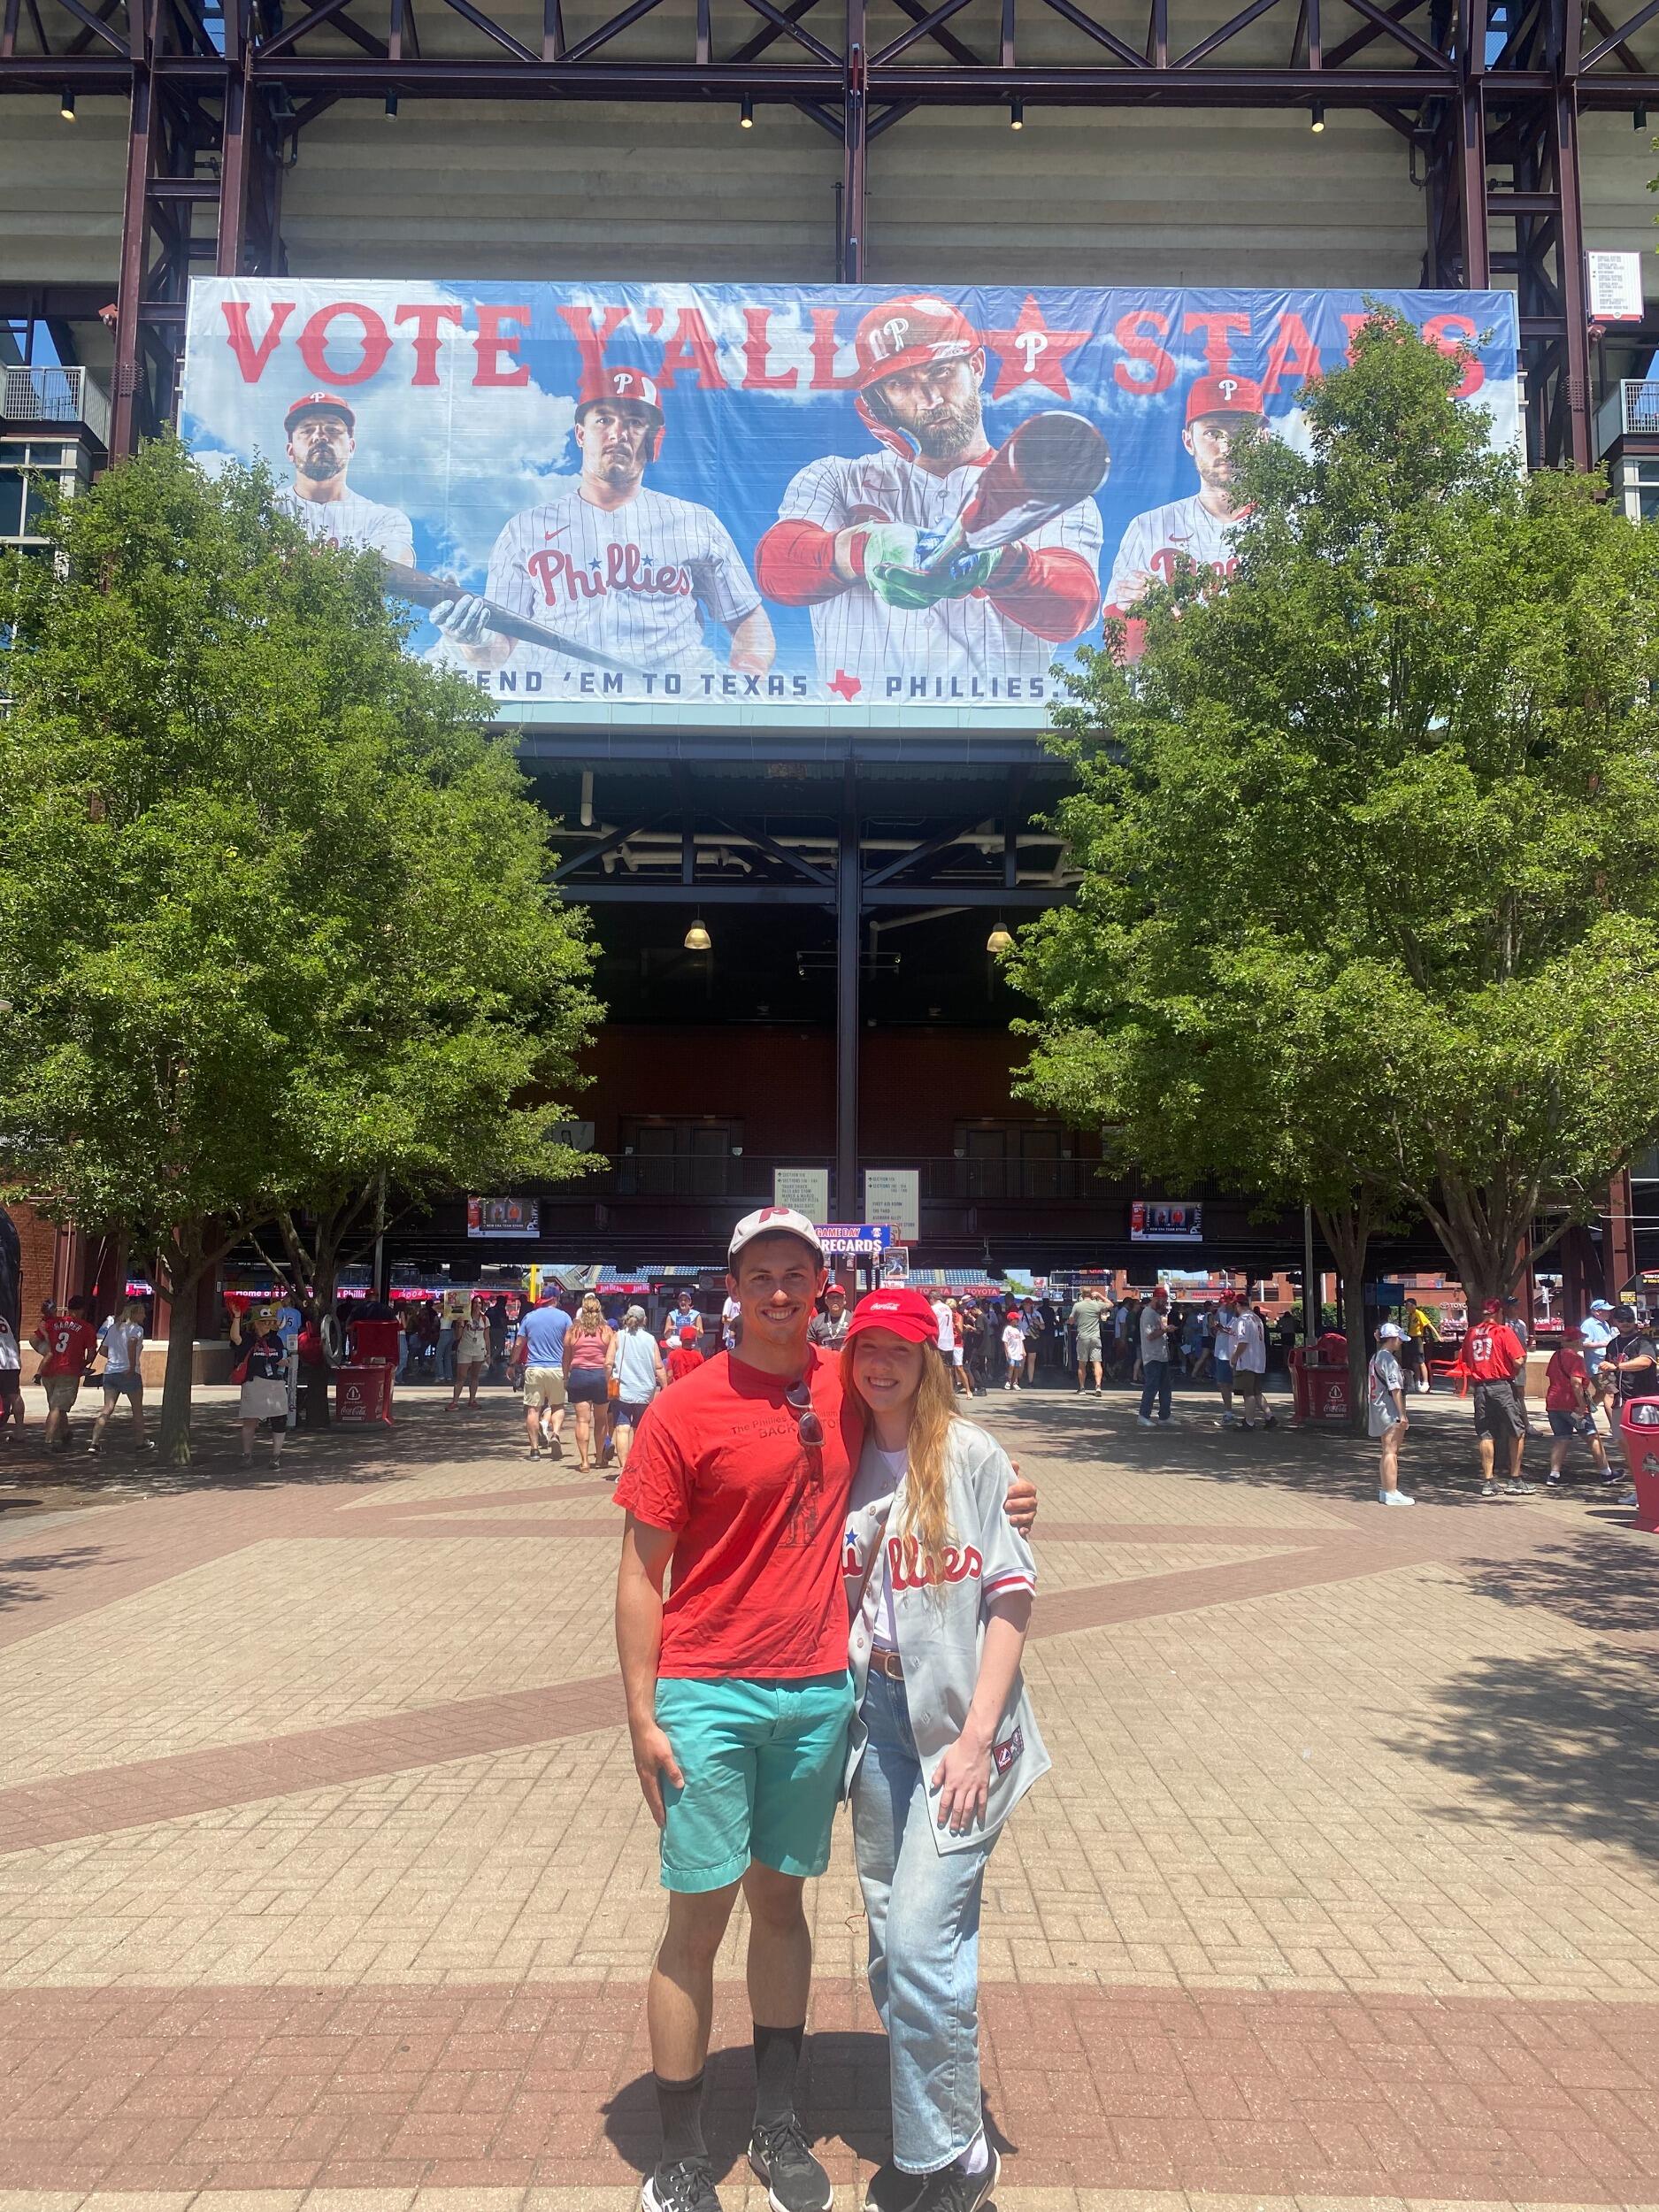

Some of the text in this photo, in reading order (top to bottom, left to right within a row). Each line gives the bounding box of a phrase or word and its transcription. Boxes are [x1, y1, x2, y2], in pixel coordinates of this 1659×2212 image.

[221, 302, 530, 386] VOTE
[528, 543, 690, 606] Phillies
[456, 670, 541, 692] END
[643, 673, 681, 695] TO
[701, 674, 807, 695] TEXAS
[815, 1228, 861, 1238] GAME DAY
[55, 1332, 70, 1353] 3
[1472, 1338, 1493, 1361] 27
[731, 1423, 750, 1435] The
[758, 1422, 796, 1439] BACK
